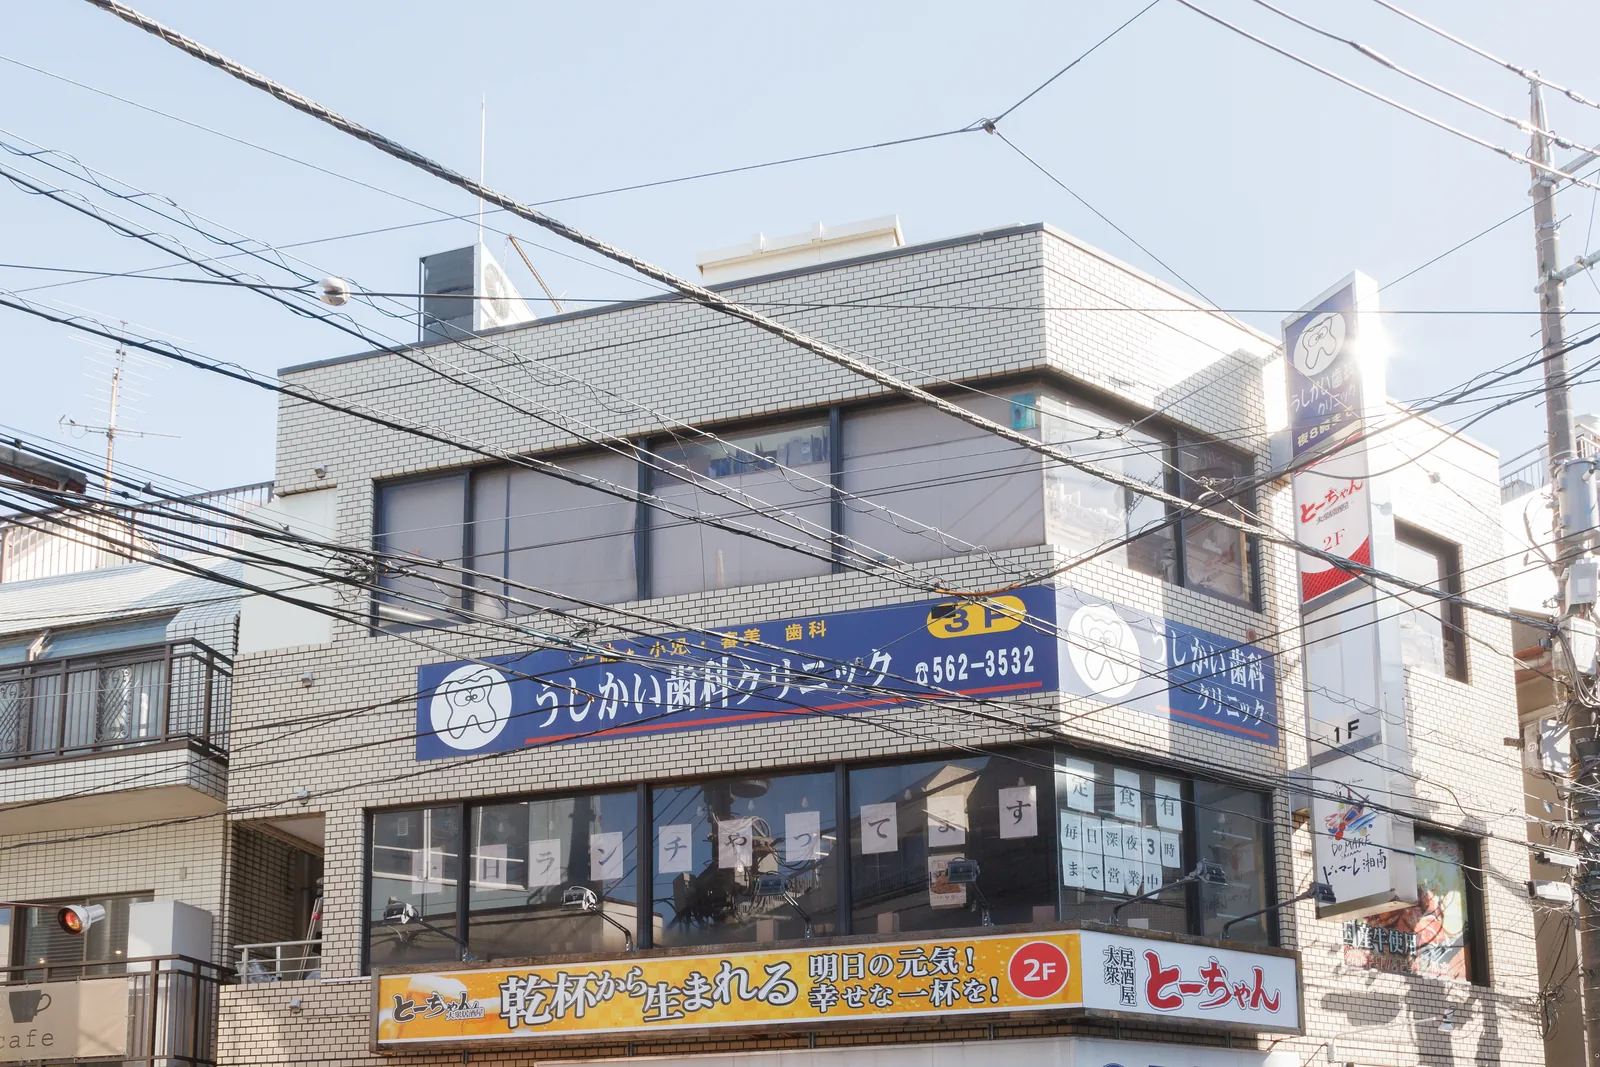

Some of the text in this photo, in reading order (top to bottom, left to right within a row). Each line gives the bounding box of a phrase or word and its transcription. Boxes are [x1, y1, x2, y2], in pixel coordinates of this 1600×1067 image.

[1300, 479, 1363, 523] とーちゃん
[1323, 528, 1346, 552] 2F
[785, 620, 828, 641] 歯科
[933, 645, 1034, 683] 562-3532
[1151, 627, 1265, 692] うしかい歯科
[536, 649, 892, 728] うしかい歯科クリニック
[1198, 684, 1266, 726] クリニック
[1334, 719, 1360, 743] 1F
[1071, 777, 1176, 817] 定食有
[1064, 823, 1176, 858] 毎日深夜3時
[1068, 861, 1158, 886] まで営業中
[1023, 958, 1057, 982] 2F
[1143, 949, 1281, 1013] とーちゃん
[392, 991, 480, 1023] とーちゃん
[498, 960, 798, 1029] 乾杯から生まれる
